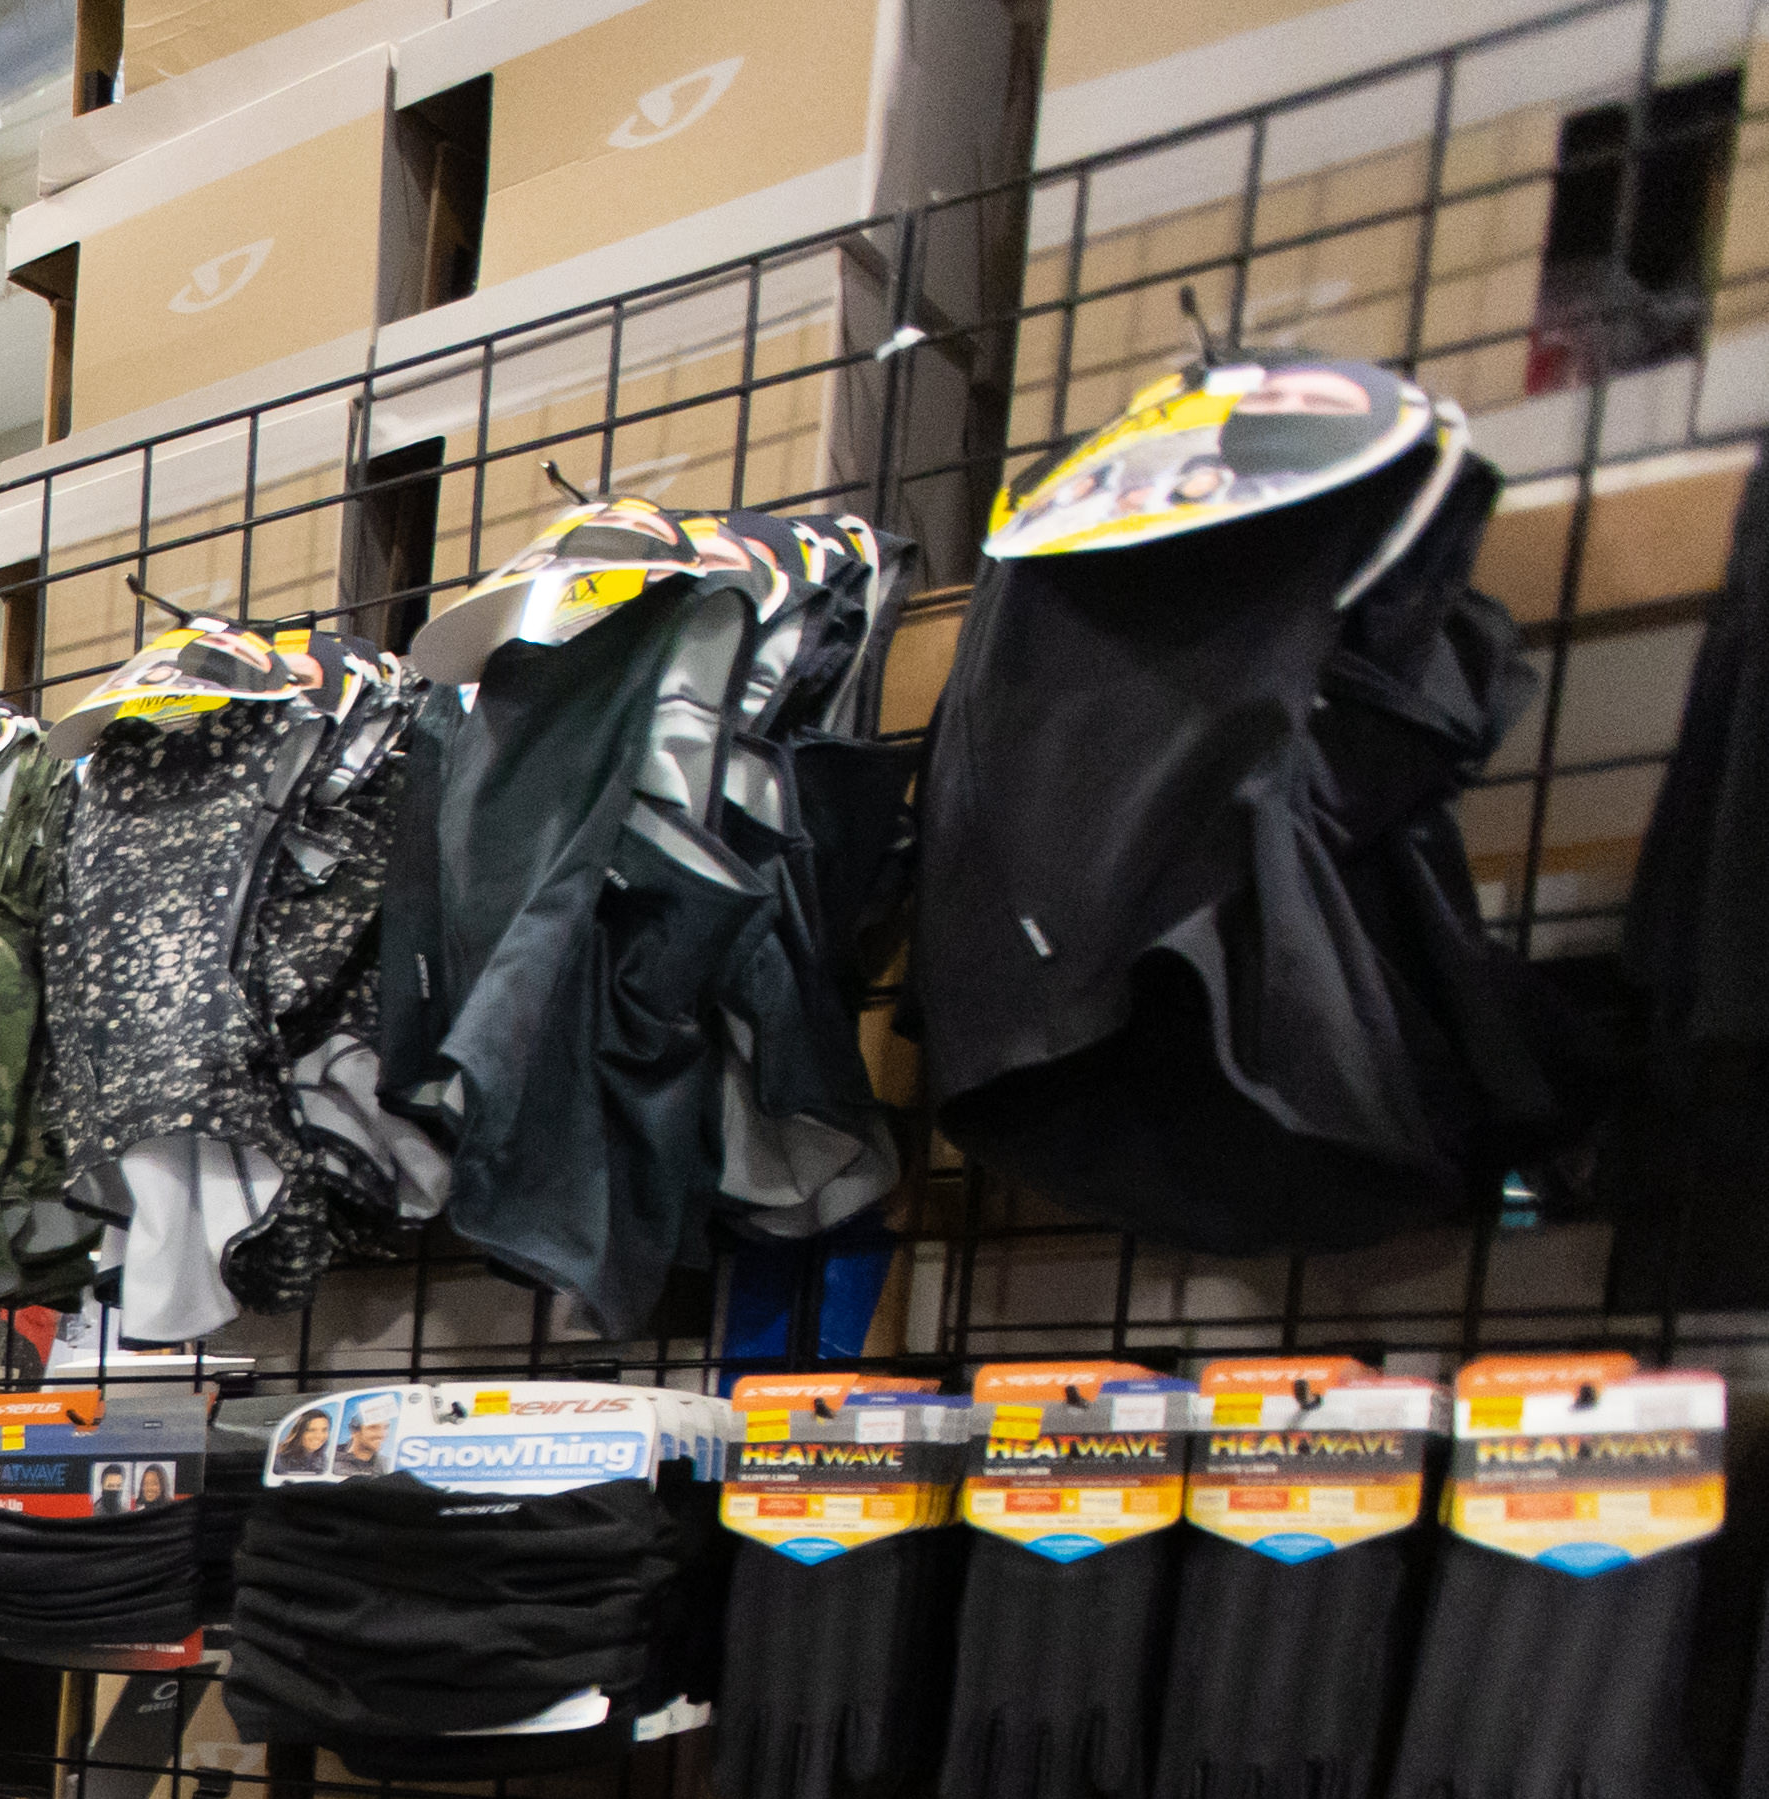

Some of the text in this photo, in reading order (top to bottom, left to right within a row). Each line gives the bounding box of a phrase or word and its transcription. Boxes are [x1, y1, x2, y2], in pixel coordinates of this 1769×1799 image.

[511, 1396, 636, 1417] eirus
[397, 1434, 638, 1472] SnowThing
[740, 1443, 905, 1467] HEATWAVE
[986, 1434, 1167, 1460] HEATWAVE
